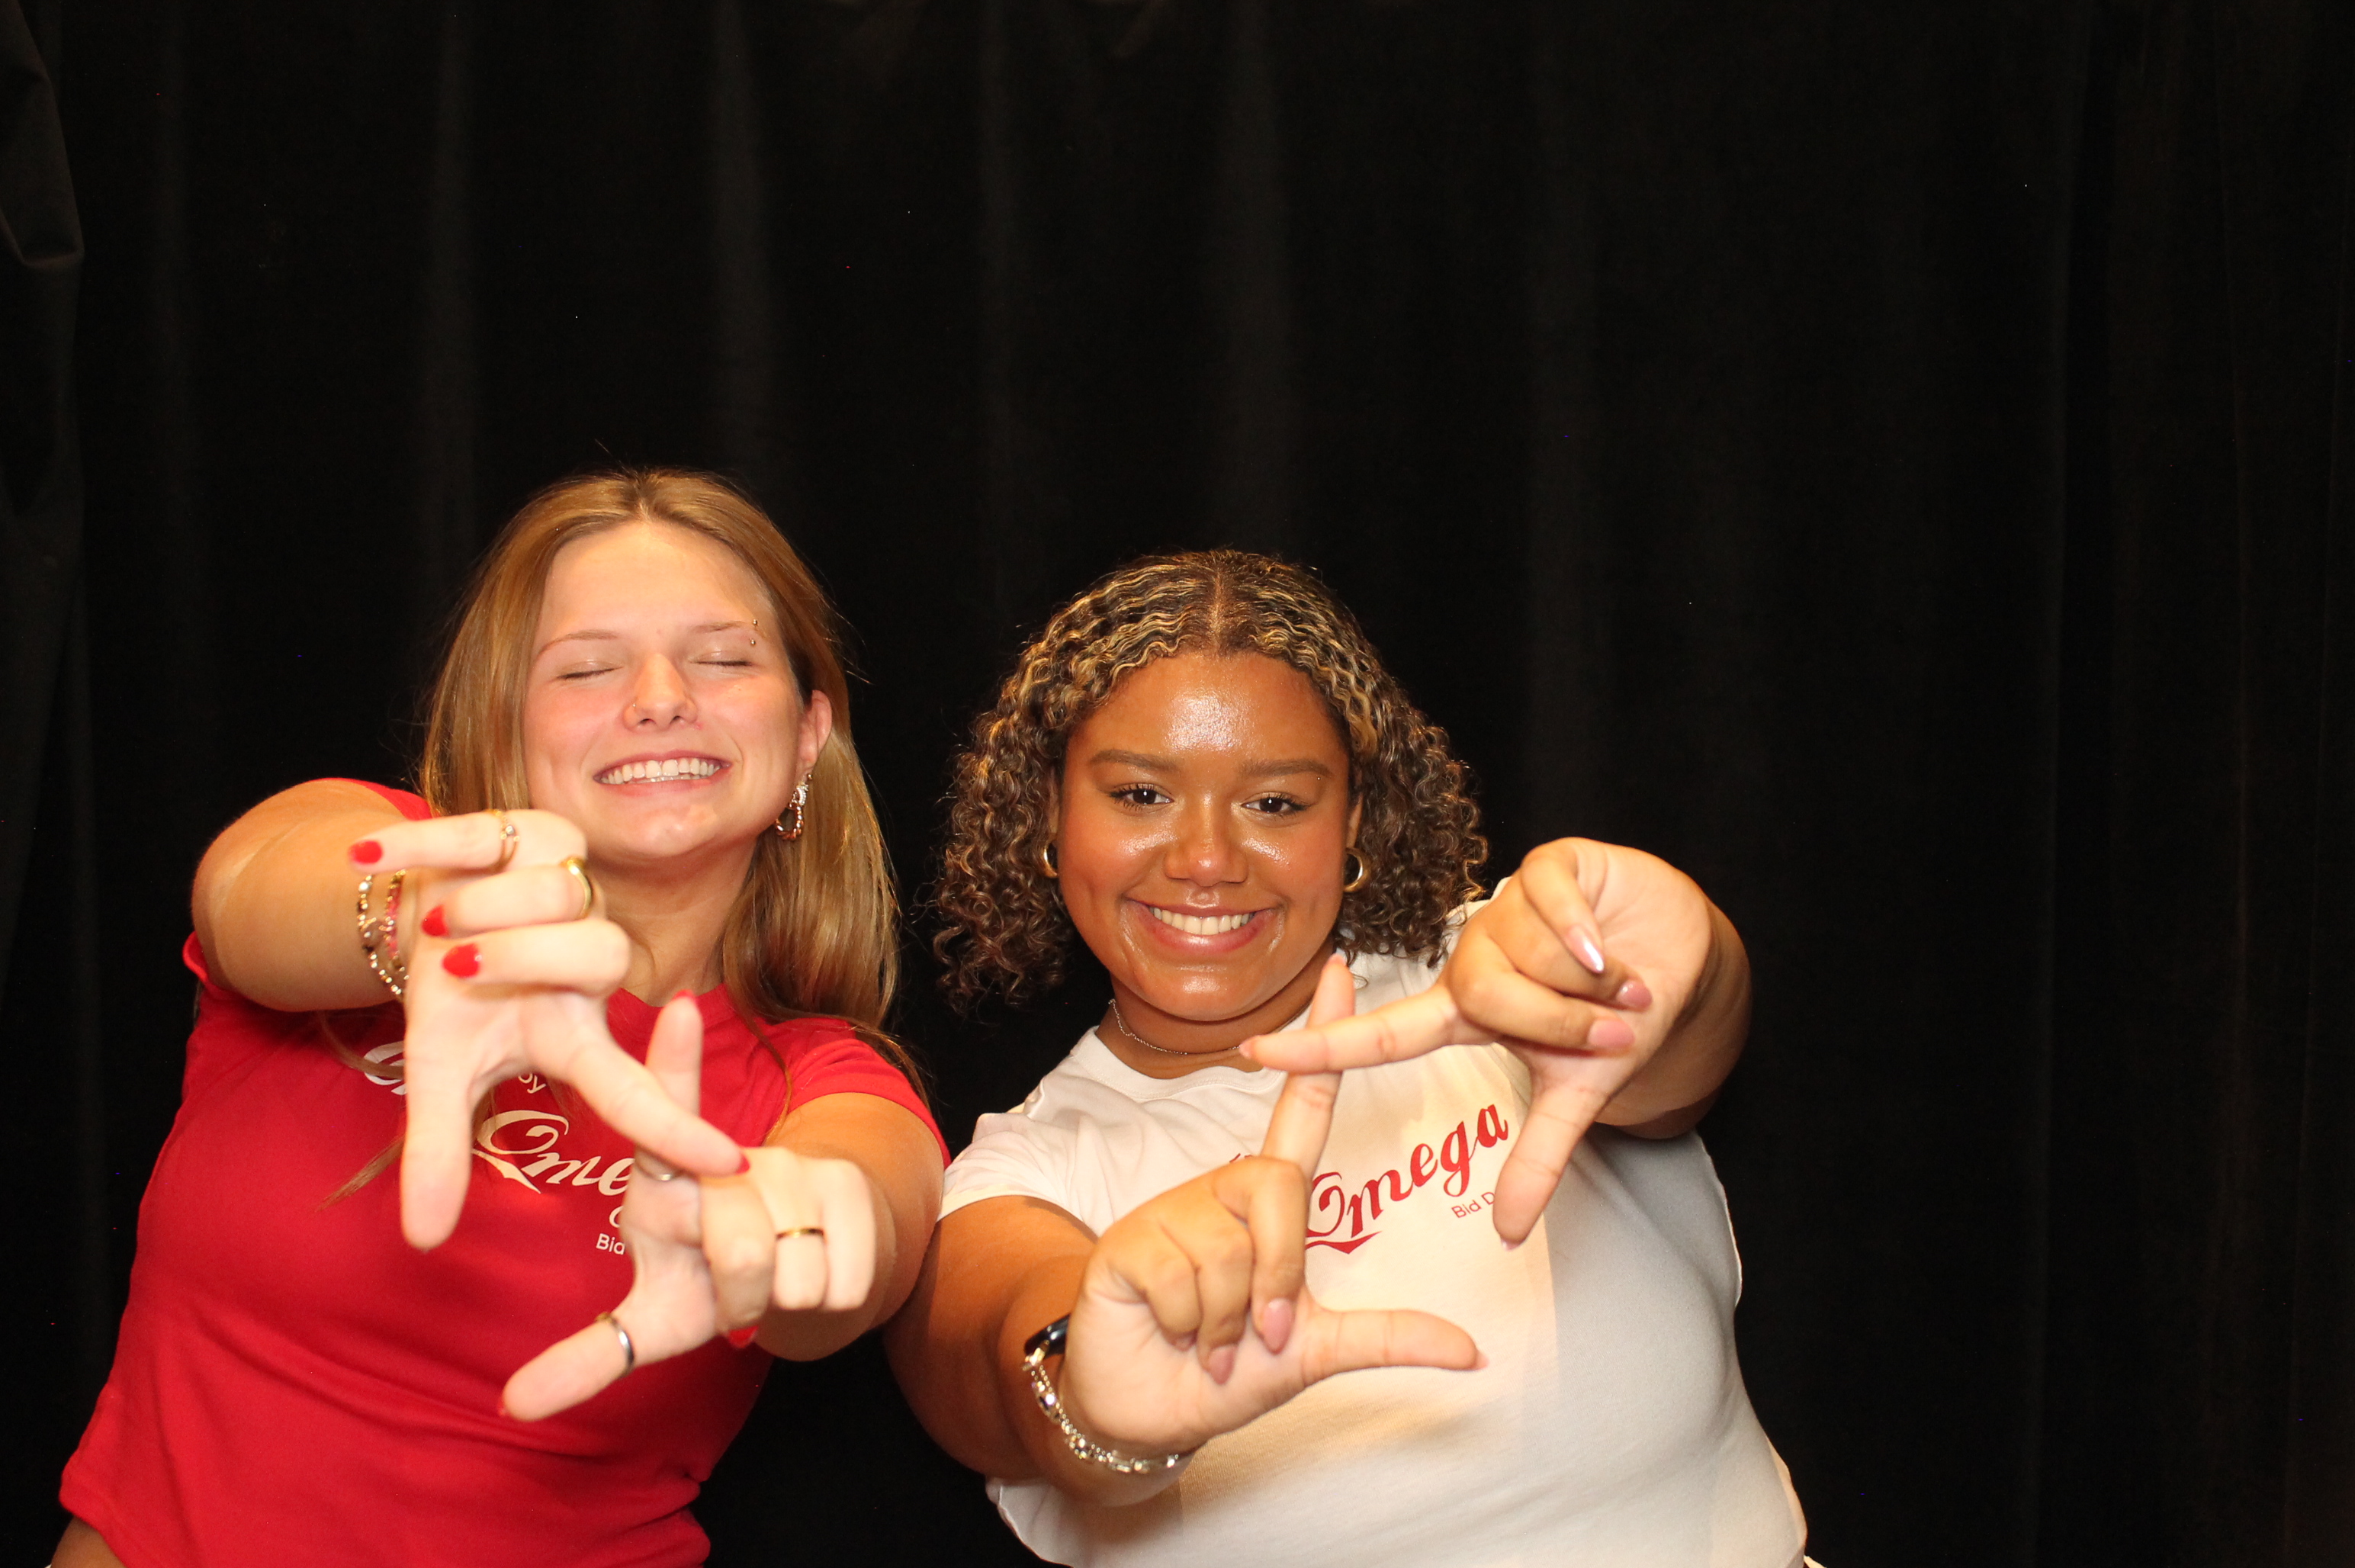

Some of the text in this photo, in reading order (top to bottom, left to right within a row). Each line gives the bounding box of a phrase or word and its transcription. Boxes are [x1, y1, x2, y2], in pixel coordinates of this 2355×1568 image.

[471, 1110, 635, 1228] Ome
[1305, 1104, 1508, 1254] Omega
[1451, 1199, 1482, 1218] Bid
